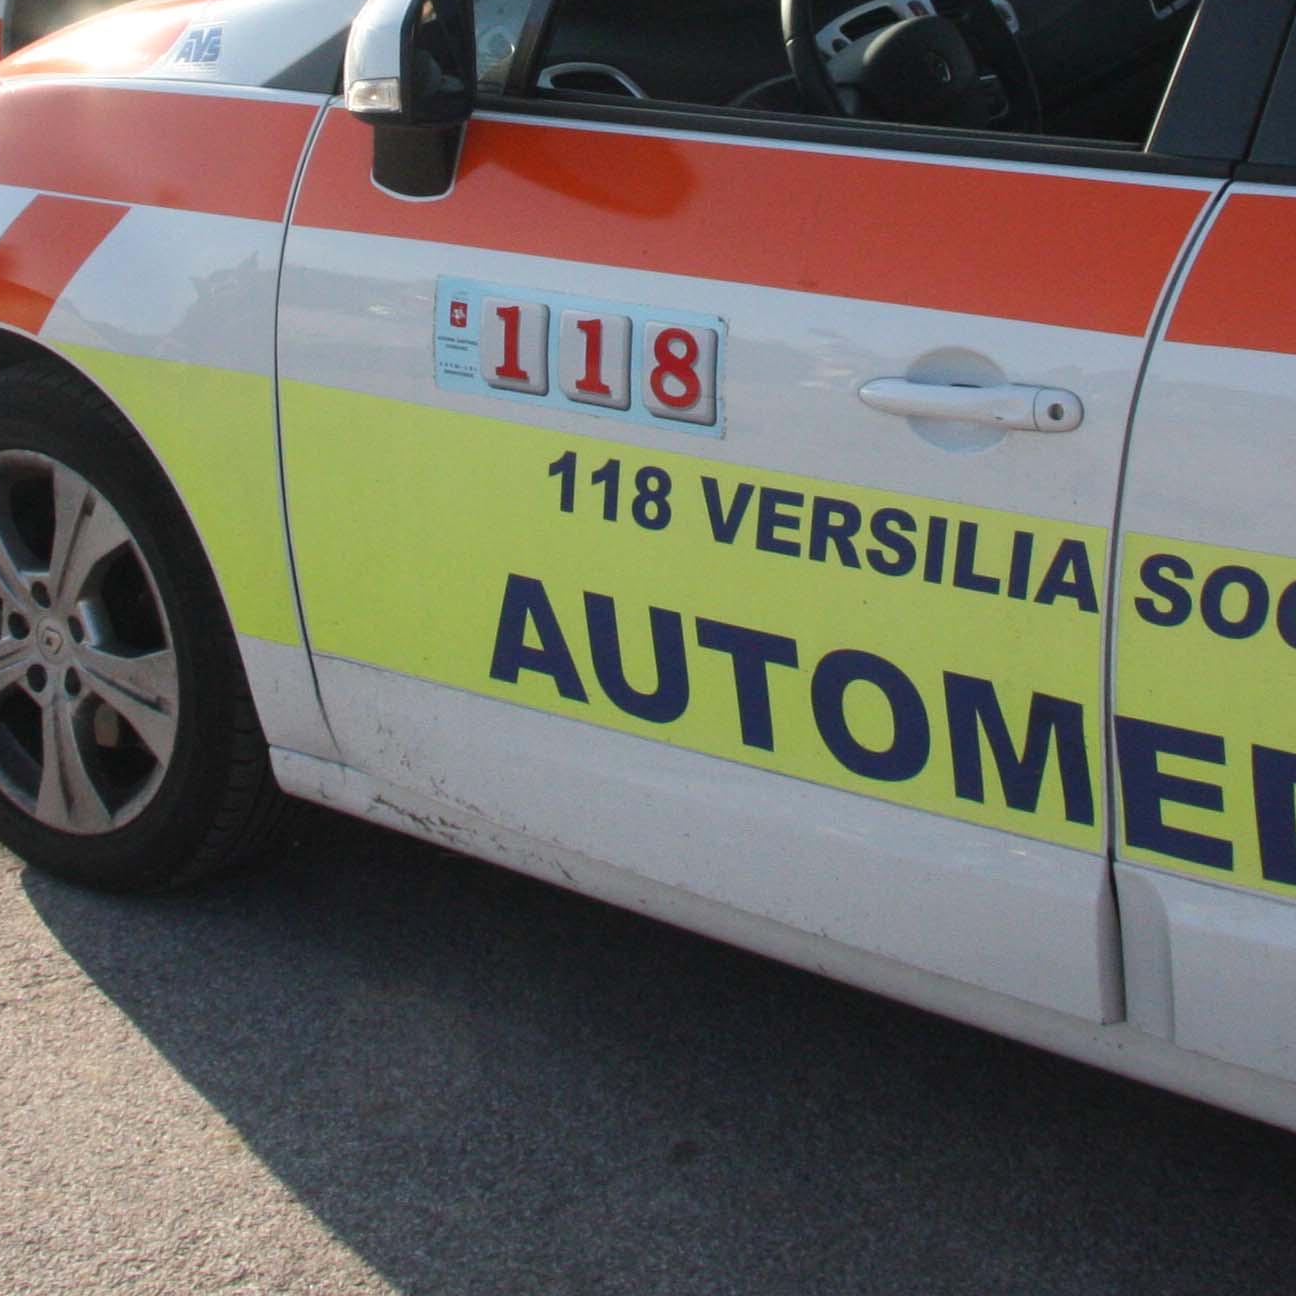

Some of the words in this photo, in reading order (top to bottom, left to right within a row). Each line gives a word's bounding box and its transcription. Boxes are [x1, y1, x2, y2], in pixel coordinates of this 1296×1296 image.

[495, 305, 702, 409] 118
[547, 450, 674, 532] 118
[699, 475, 1100, 615] VERSILIA
